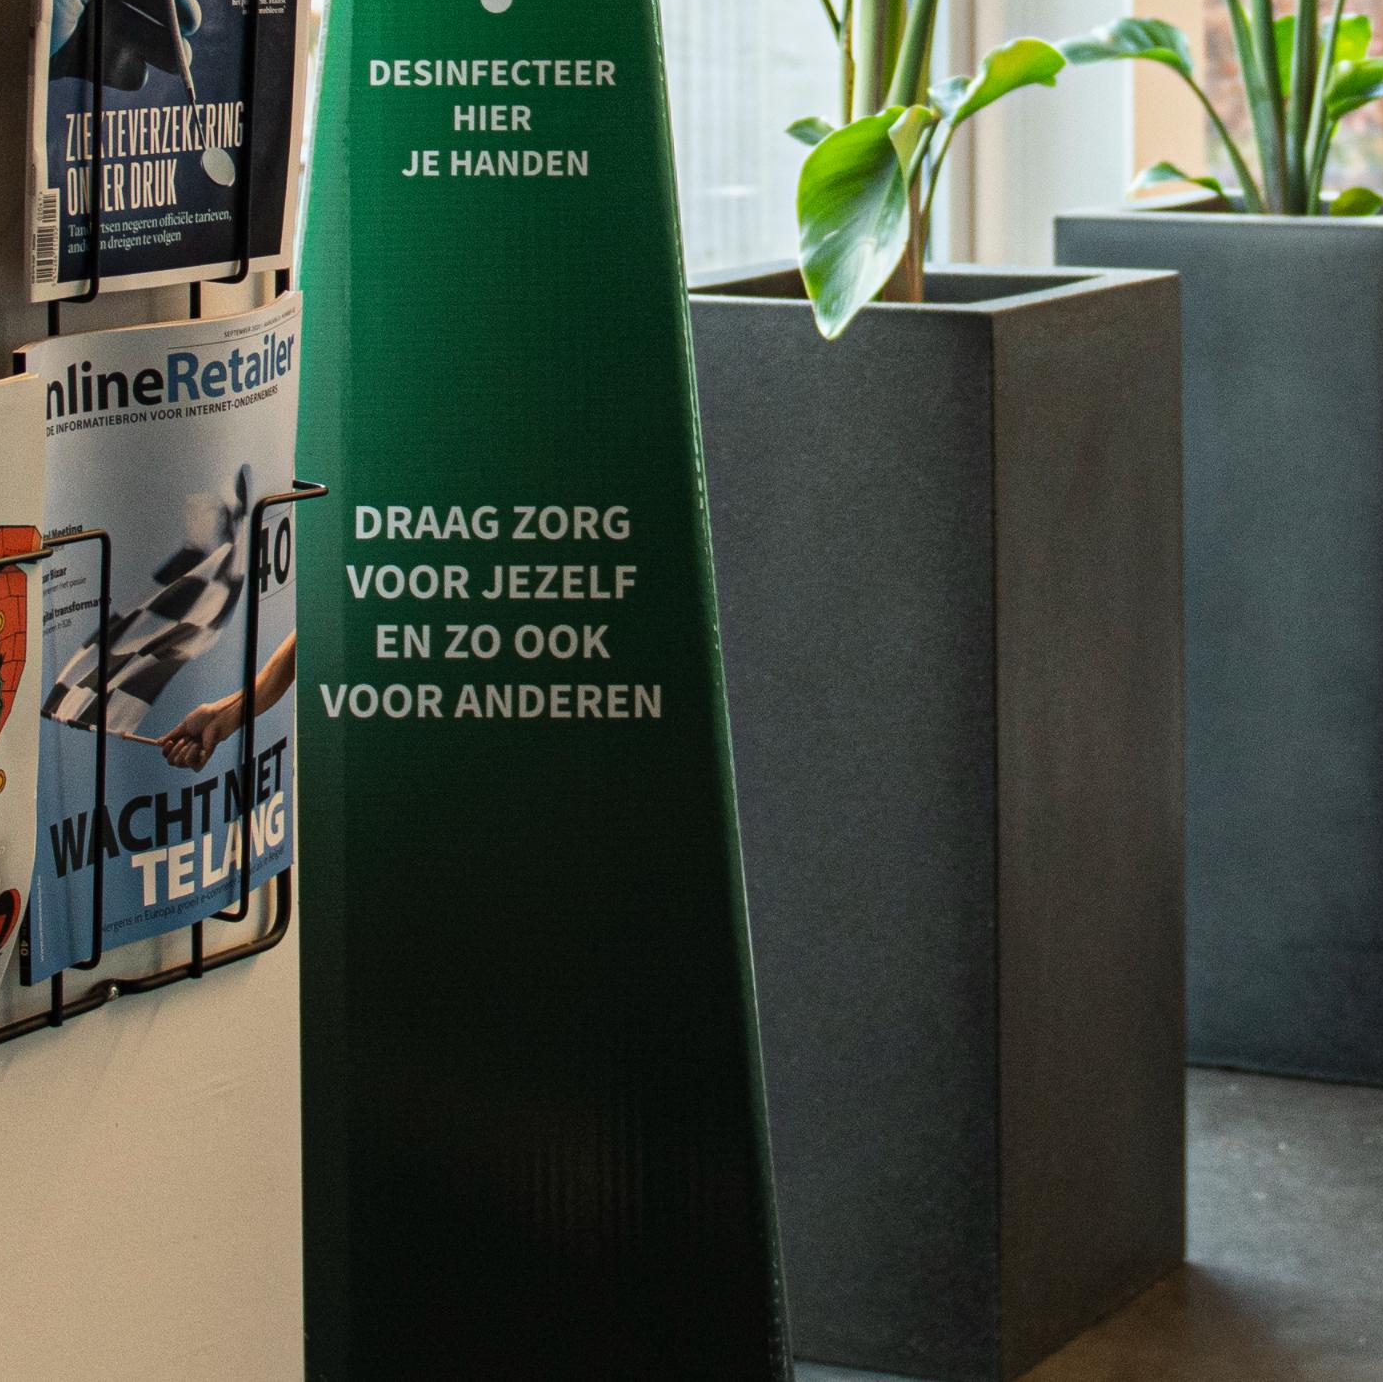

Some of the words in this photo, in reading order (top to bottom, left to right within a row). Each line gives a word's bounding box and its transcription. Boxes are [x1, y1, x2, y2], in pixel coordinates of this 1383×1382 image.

[369, 60, 617, 87] DESINFECTEER
[65, 101, 245, 162] ZIETEVERZEKERING
[454, 105, 532, 131] HIER
[402, 150, 440, 177] JE
[450, 150, 589, 176] HANDEN
[66, 164, 125, 217] ONER
[131, 159, 178, 210] DRUK
[108, 233, 141, 251] dreigen
[142, 234, 151, 245] te
[152, 230, 182, 247] volgen
[122, 218, 158, 233] negeren
[46, 331, 296, 421] nlineRetailer
[55, 412, 148, 436] INFORMATIEBRON
[149, 408, 183, 422] VOOR
[185, 384, 279, 419] INTERNET-ONDERNEMERS
[355, 505, 500, 541] DRAAG
[512, 505, 631, 541] ZORG
[346, 564, 470, 600] VOOR
[481, 564, 637, 600] JEZELF
[376, 624, 430, 659] EN
[444, 624, 502, 660] ZO
[514, 624, 611, 660] OOK
[319, 684, 444, 719] VOOR
[454, 684, 662, 719] ANDEREN
[50, 778, 219, 879] WACHT
[223, 736, 288, 826] NET
[131, 839, 196, 907] TE
[202, 789, 286, 889] LANG
